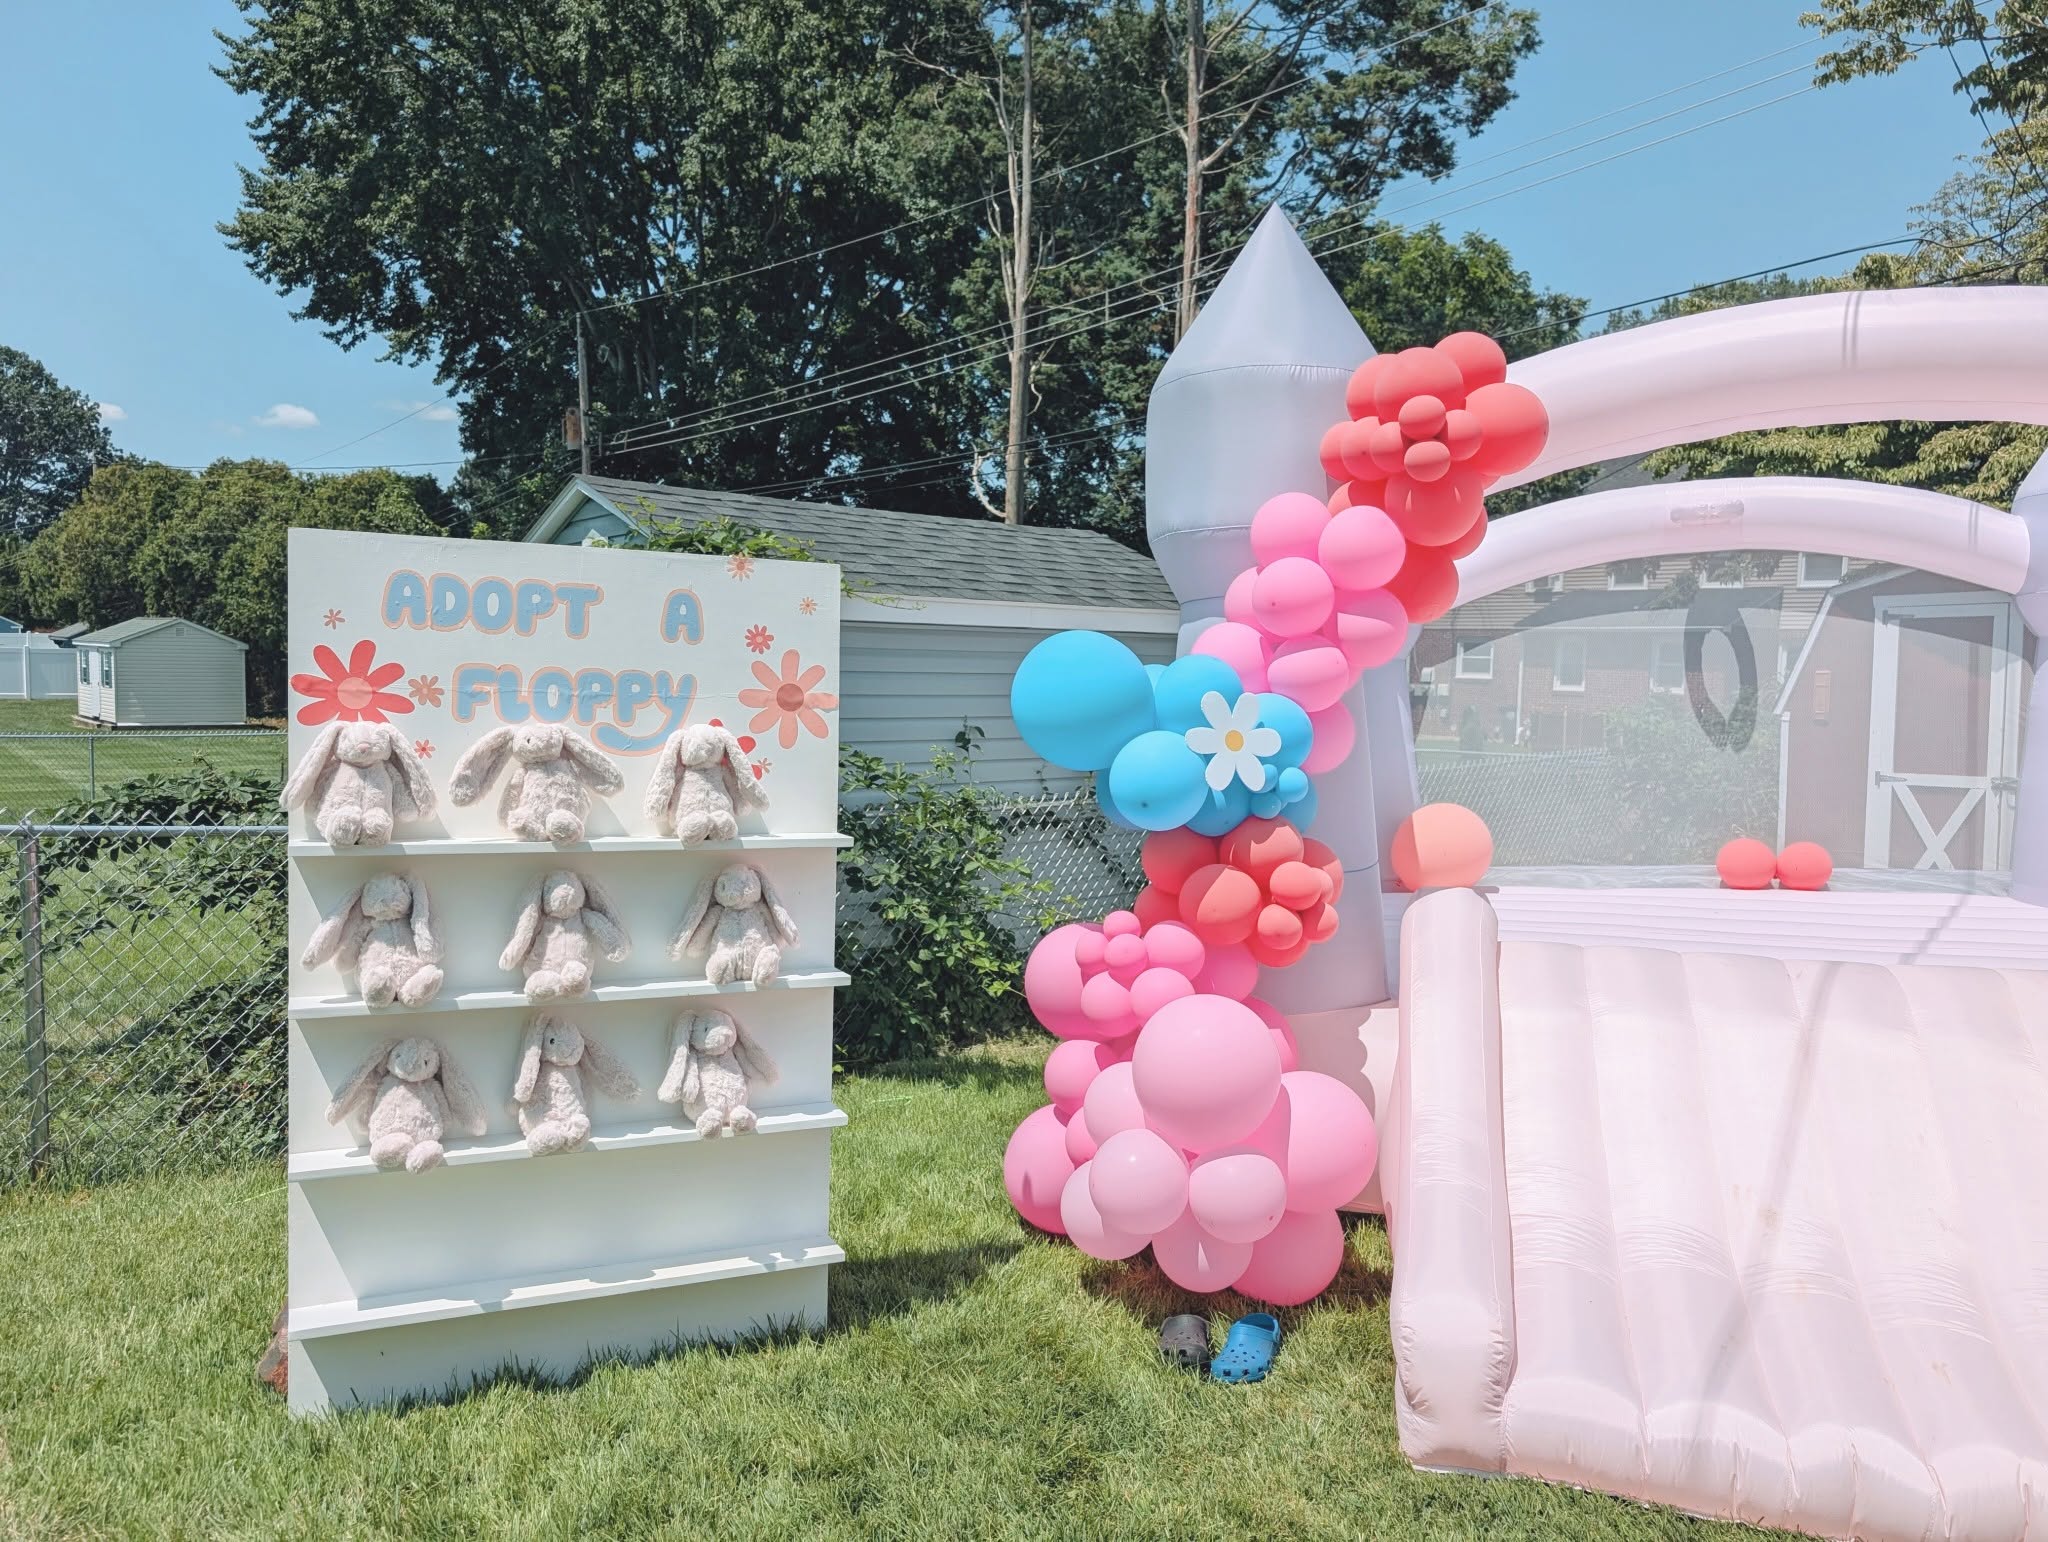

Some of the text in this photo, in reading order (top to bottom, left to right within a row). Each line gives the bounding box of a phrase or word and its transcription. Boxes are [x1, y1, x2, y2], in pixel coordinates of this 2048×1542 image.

[382, 569, 704, 645] ADOPT A
[452, 663, 698, 756] FLOPPY
